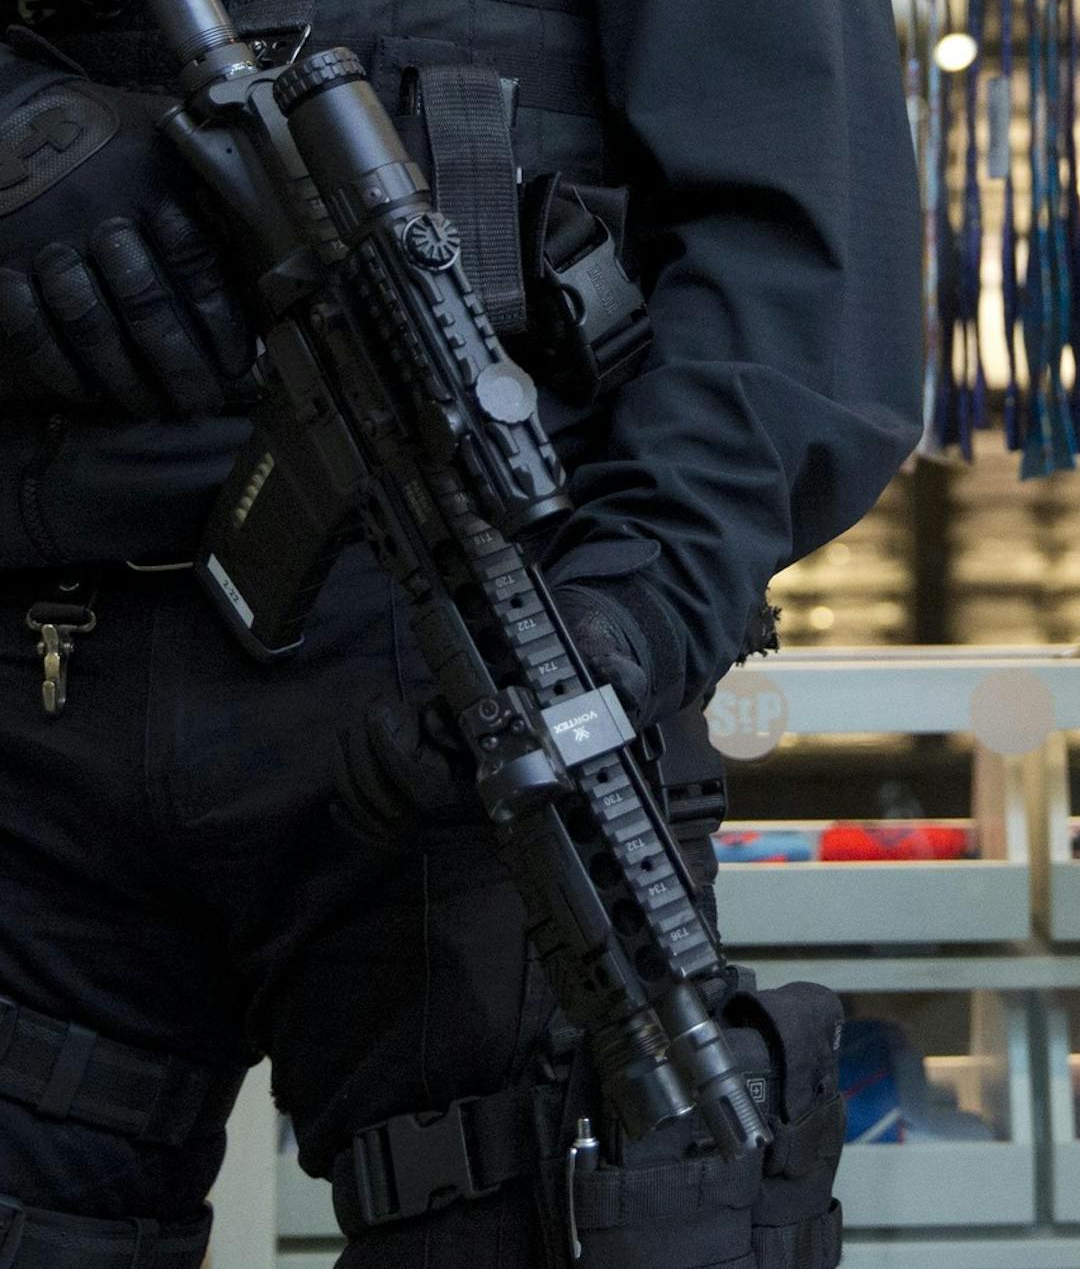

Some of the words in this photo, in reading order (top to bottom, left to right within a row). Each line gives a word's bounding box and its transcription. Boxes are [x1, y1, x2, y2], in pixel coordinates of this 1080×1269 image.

[495, 574, 515, 588] T20
[516, 618, 537, 632] T22
[538, 660, 559, 675] T24
[553, 710, 599, 735] VORTEX
[603, 792, 623, 807] T30
[625, 837, 645, 852] T32
[648, 881, 668, 896] T34
